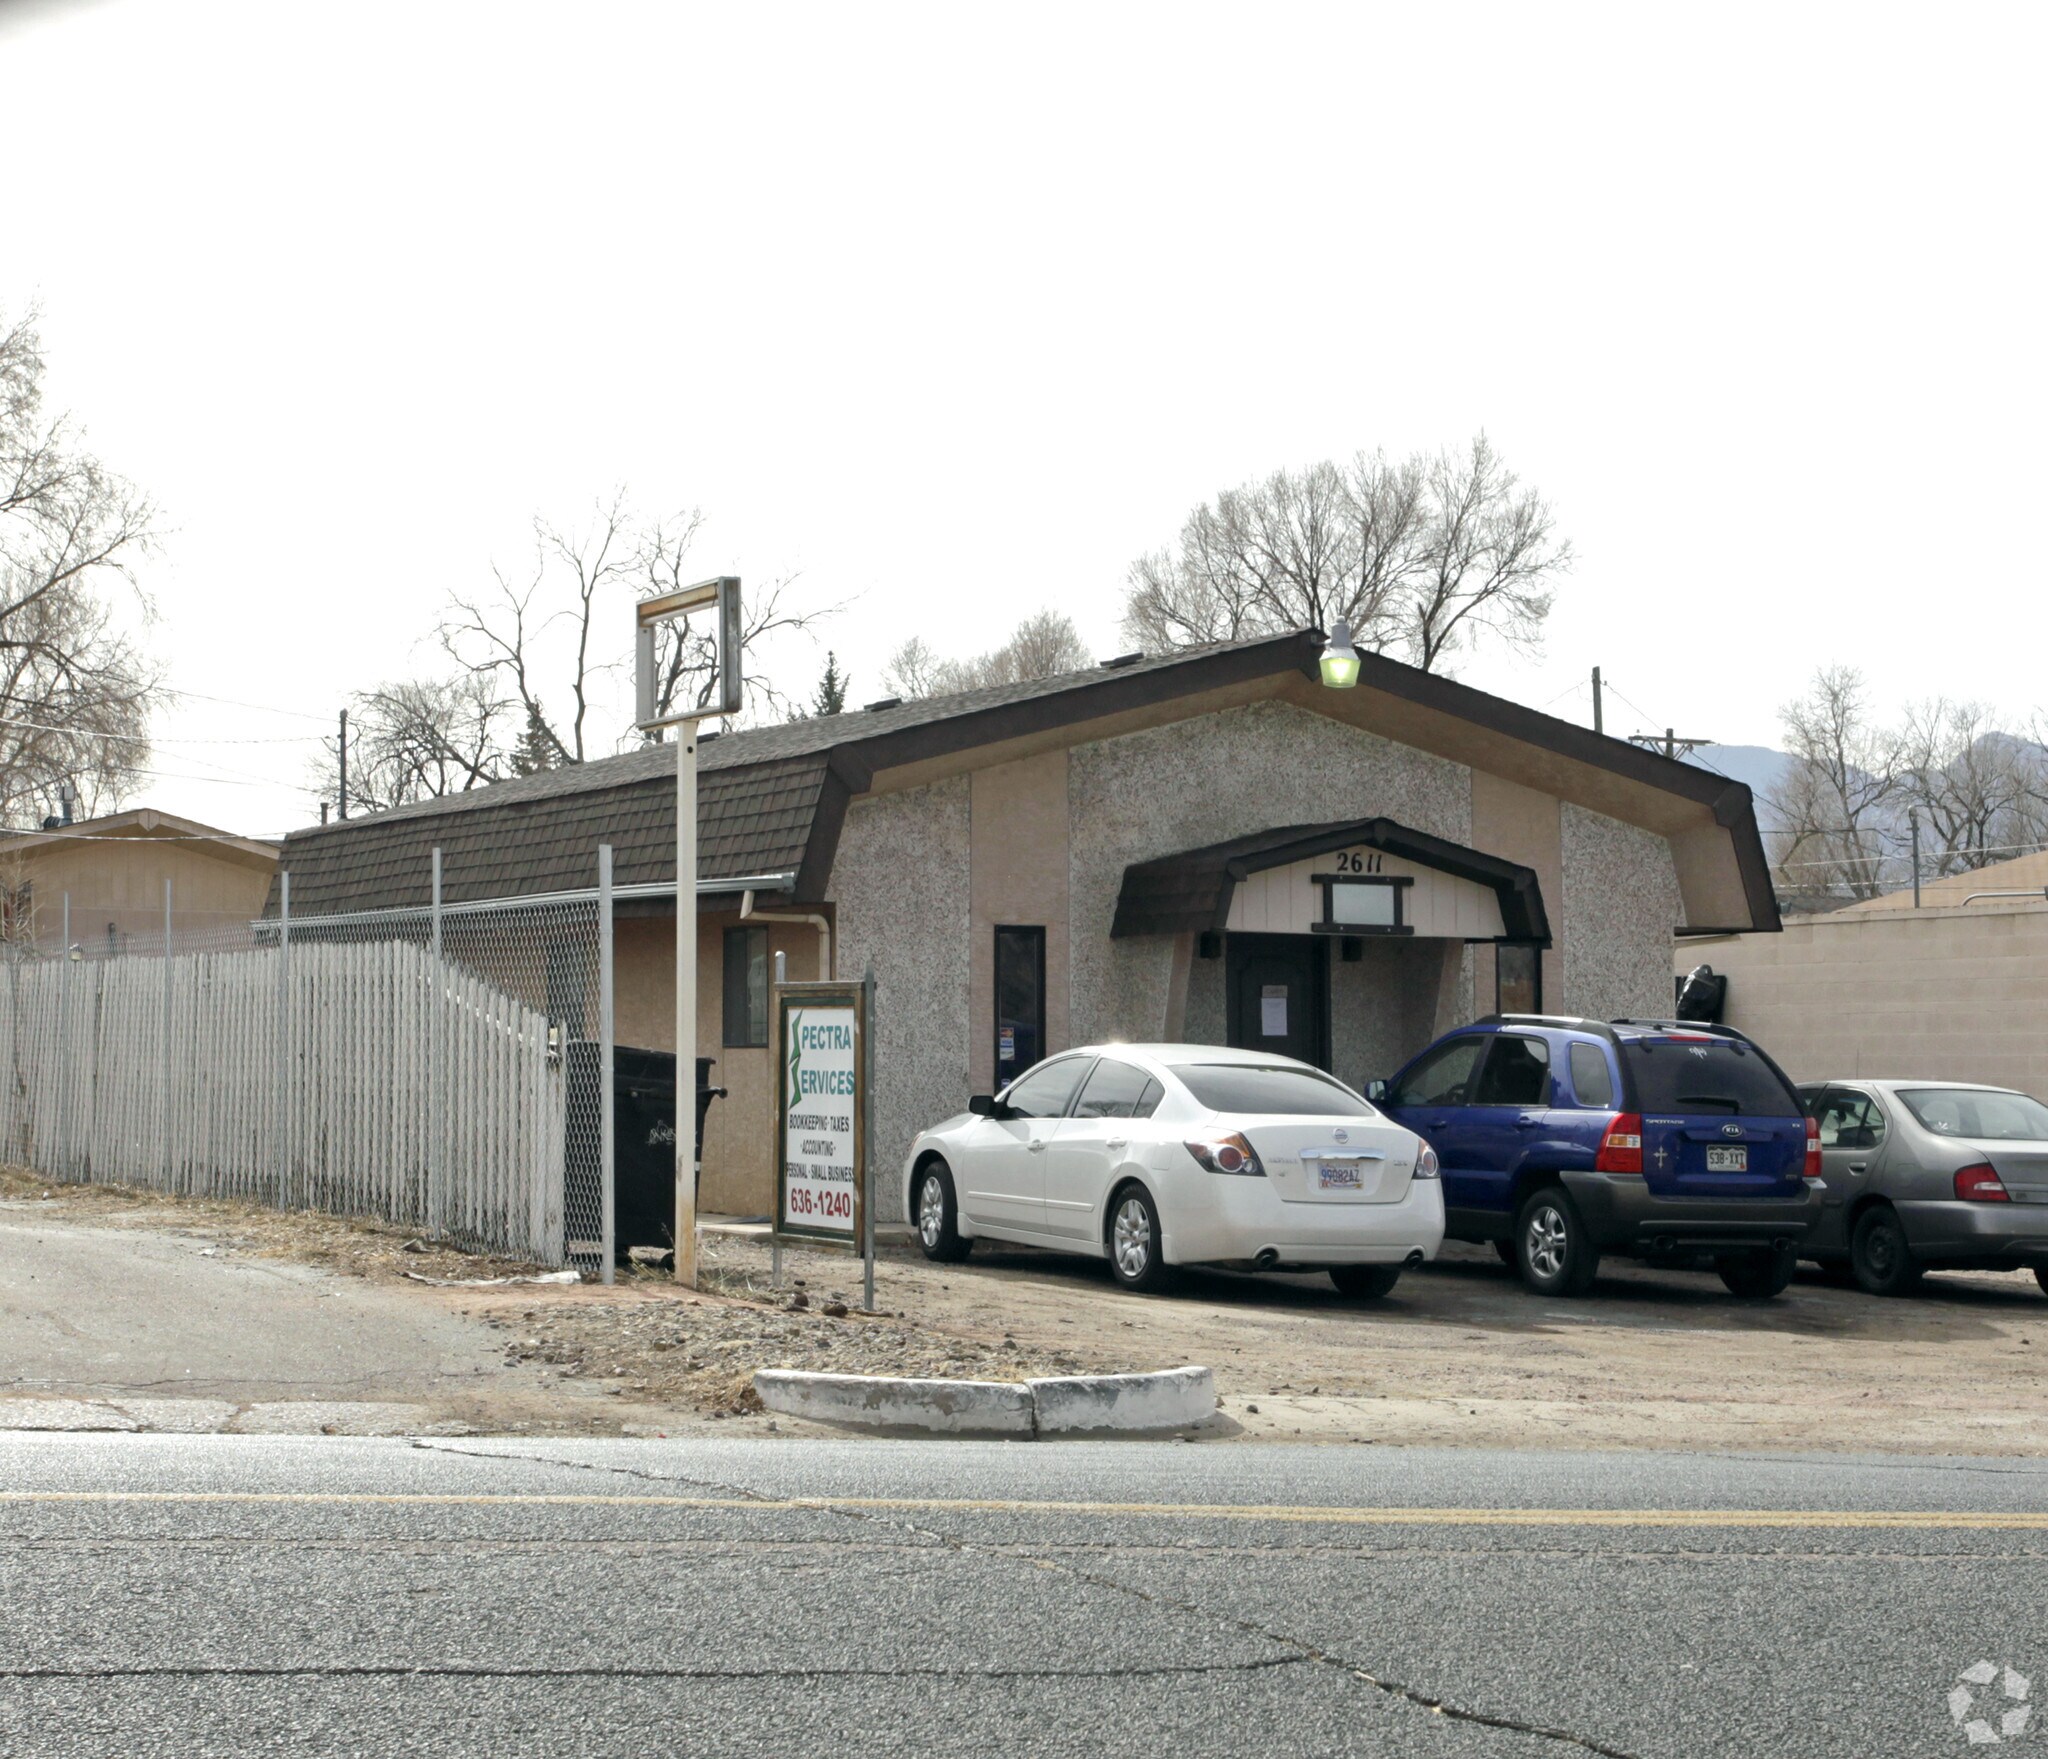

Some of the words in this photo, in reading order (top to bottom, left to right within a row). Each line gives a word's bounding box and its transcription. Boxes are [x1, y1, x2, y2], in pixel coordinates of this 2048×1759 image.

[1337, 852, 1382, 873] 2611
[830, 1116, 850, 1132] TAXES
[801, 1139, 834, 1156] ACCOUNTING
[811, 1164, 827, 1180] SMALL
[791, 1188, 851, 1218] 636-1240
